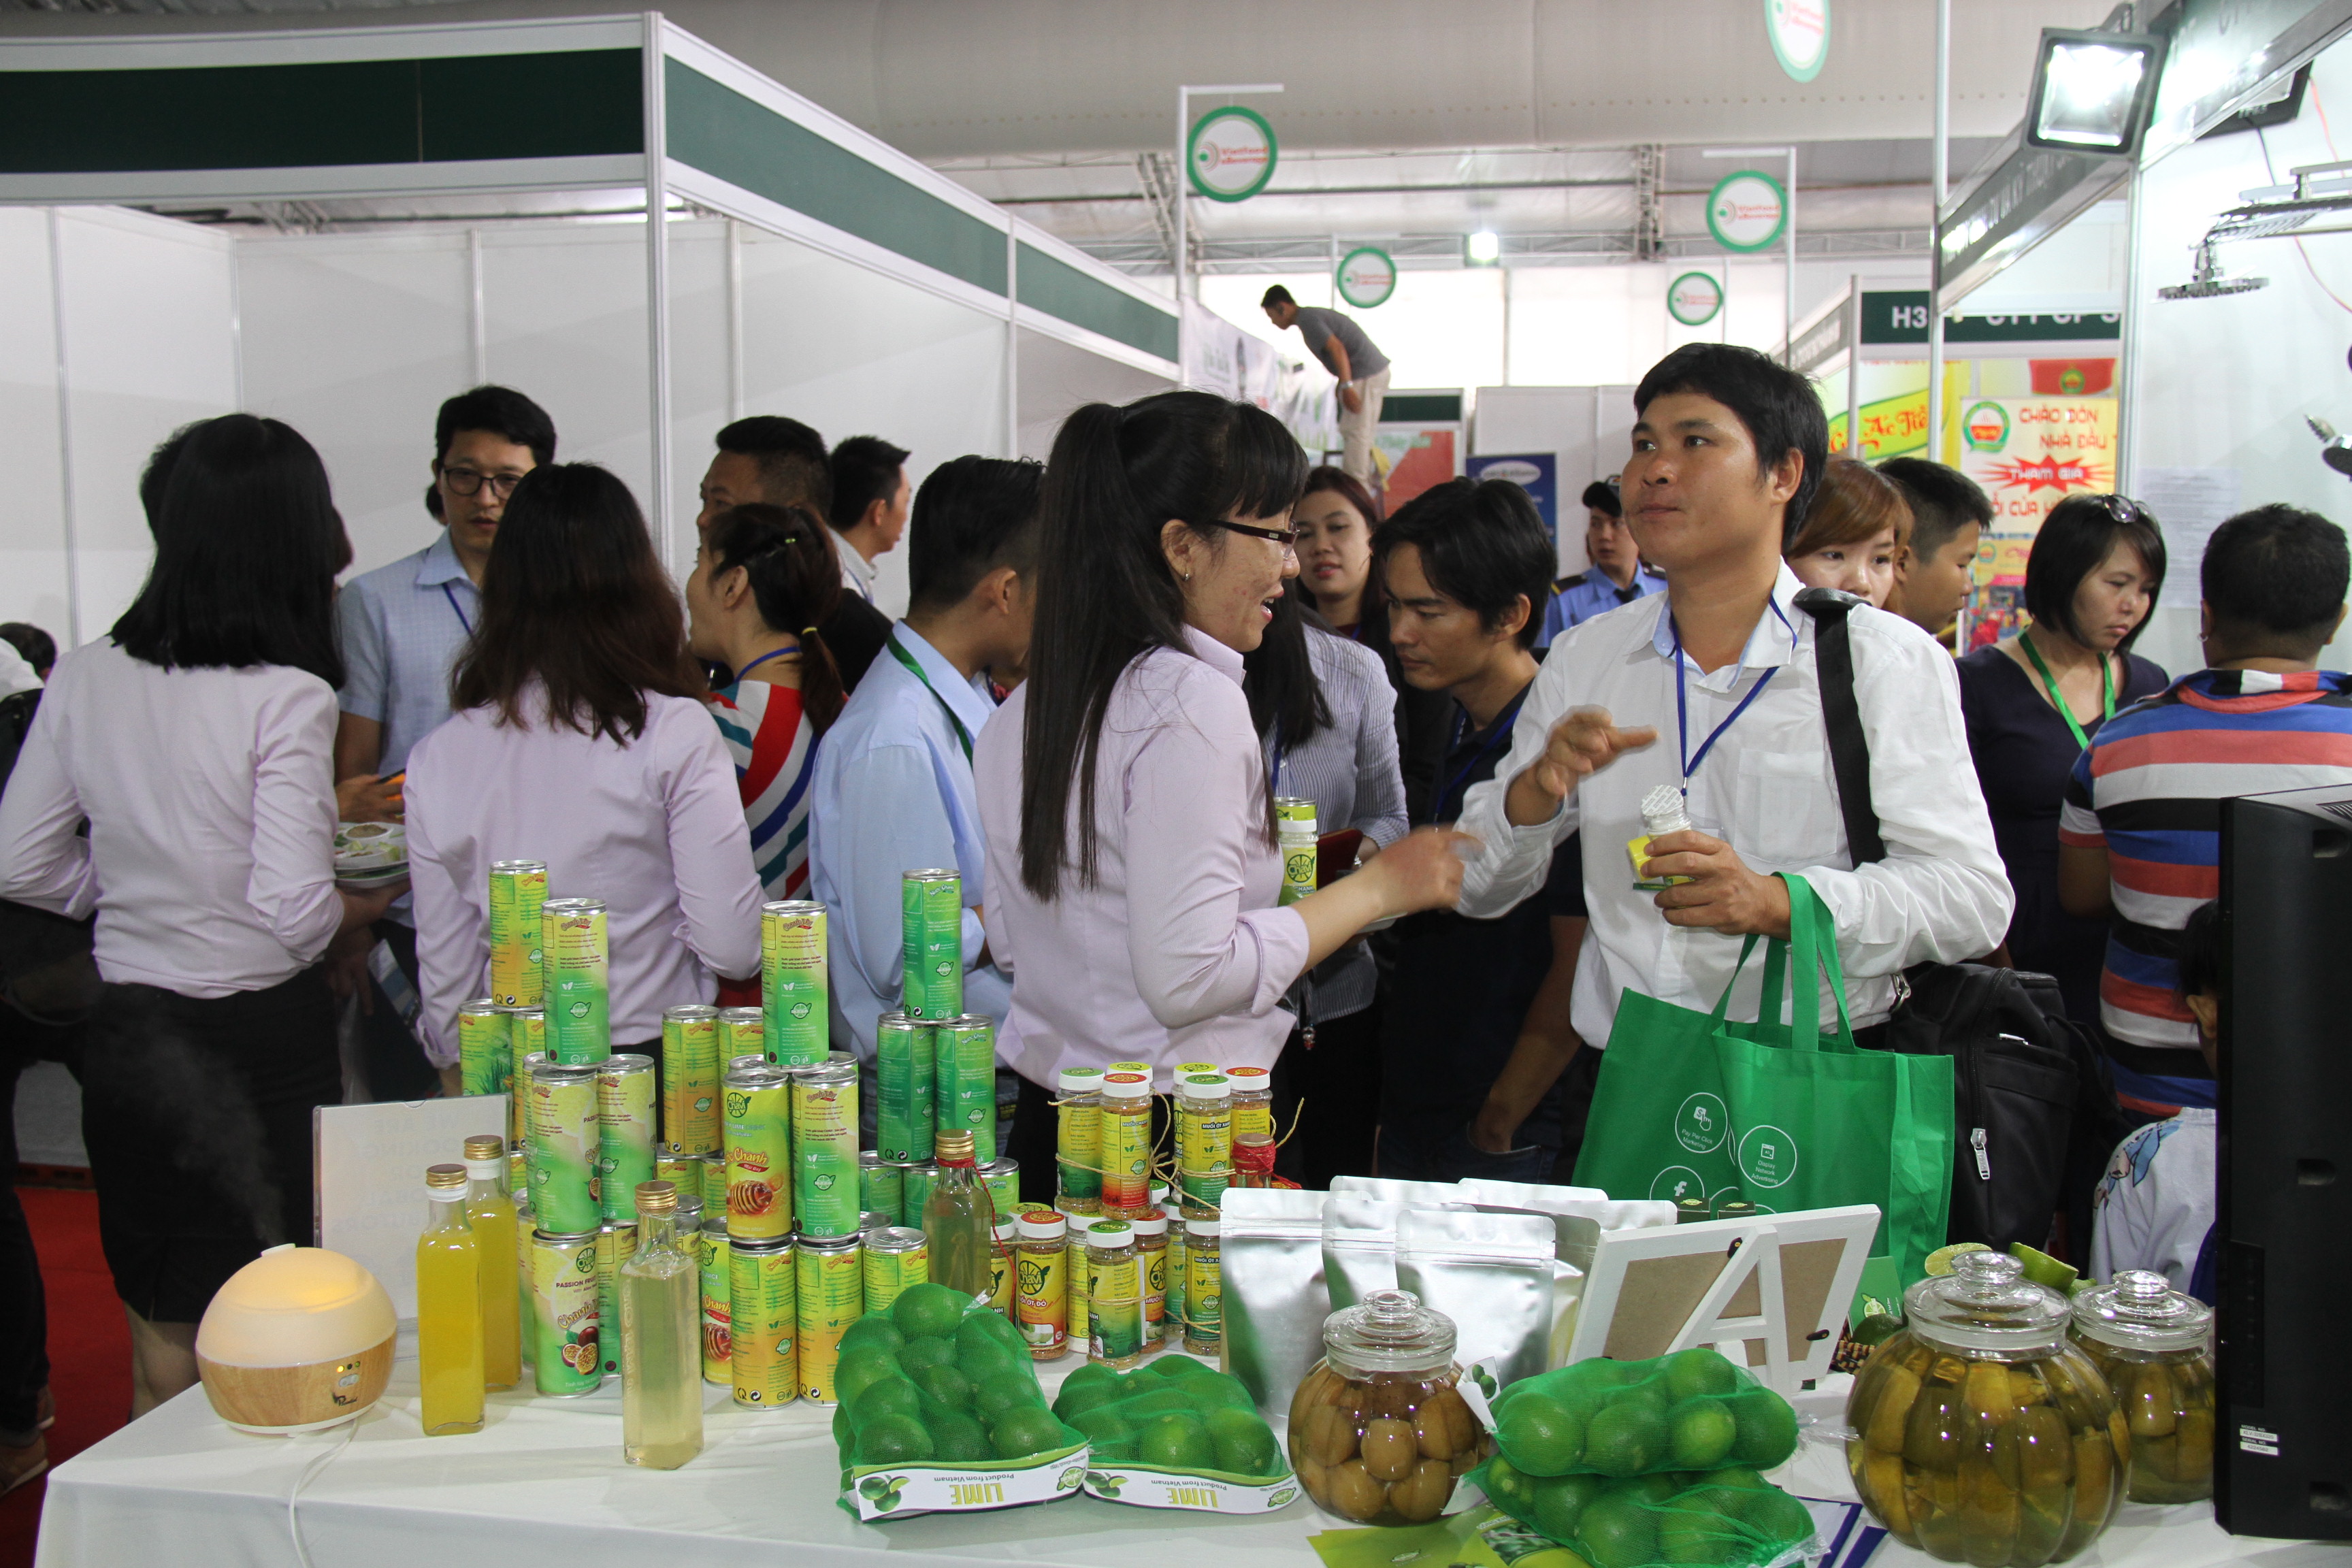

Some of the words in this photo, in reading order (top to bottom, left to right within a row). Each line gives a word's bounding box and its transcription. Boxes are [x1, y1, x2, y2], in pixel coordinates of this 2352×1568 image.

[1892, 306, 1928, 329] H3
[2008, 468, 2053, 480] THAM
[2058, 468, 2084, 480] GIA
[728, 1099, 747, 1111] Chavi
[1682, 1128, 1691, 1137] Pay
[1691, 1131, 1701, 1139] Per
[1701, 1135, 1713, 1145] Click
[1682, 1137, 1706, 1151] Marketing
[734, 1147, 768, 1166] Chanh
[1757, 1160, 1776, 1169] Display
[1755, 1166, 1775, 1176] Network
[1751, 1173, 1778, 1185] Advertising
[556, 1279, 583, 1288] PASSION
[1035, 1299, 1047, 1307] ĐỎ
[557, 1303, 591, 1330] Chanh
[985, 1473, 1014, 1481] Product
[1200, 1481, 1227, 1491] Product
[949, 1482, 1004, 1507] LIME
[1165, 1487, 1219, 1508] LIME
